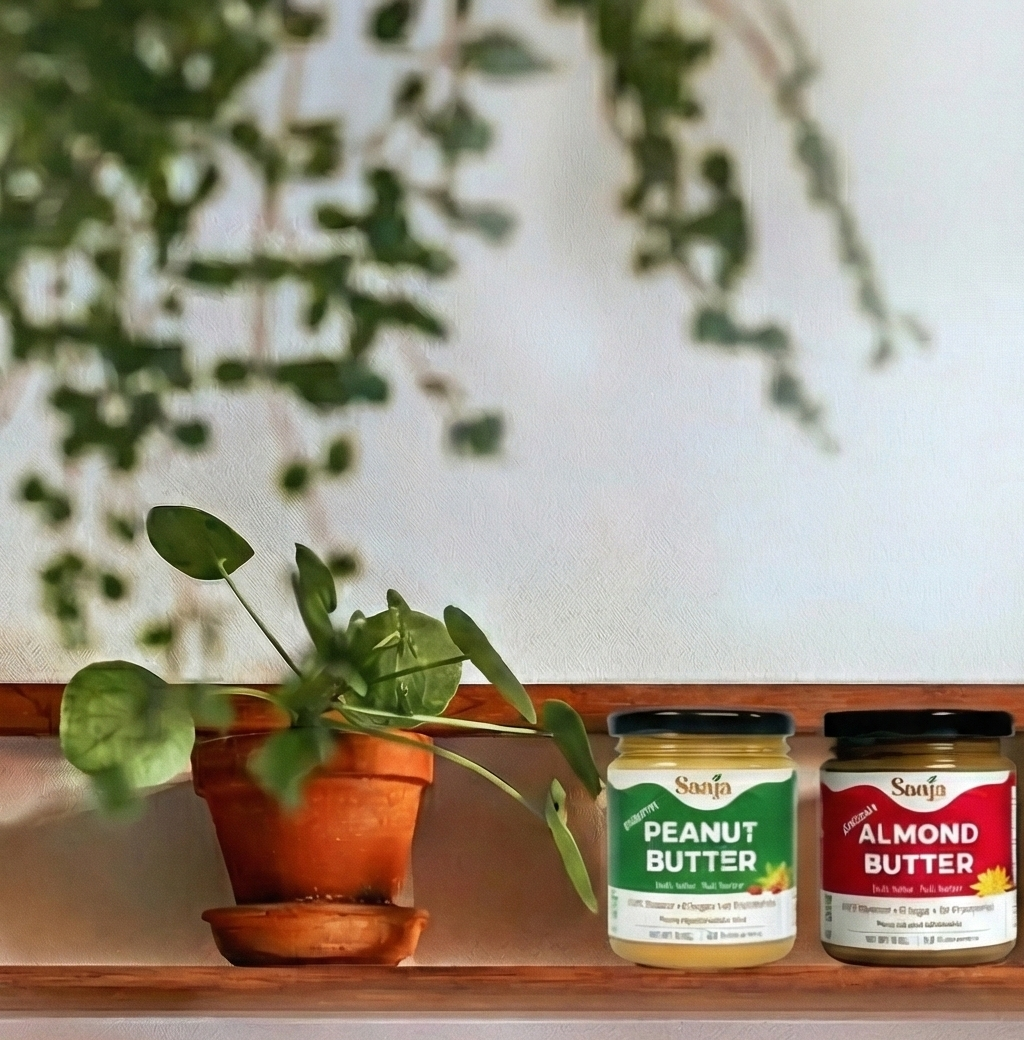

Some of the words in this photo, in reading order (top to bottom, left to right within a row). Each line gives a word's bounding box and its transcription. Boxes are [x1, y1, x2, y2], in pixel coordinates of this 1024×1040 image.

[644, 821, 758, 843] PEANUT
[858, 823, 979, 845] ALMOND
[646, 850, 757, 872] BUTTER
[864, 853, 974, 875] BUTTER
